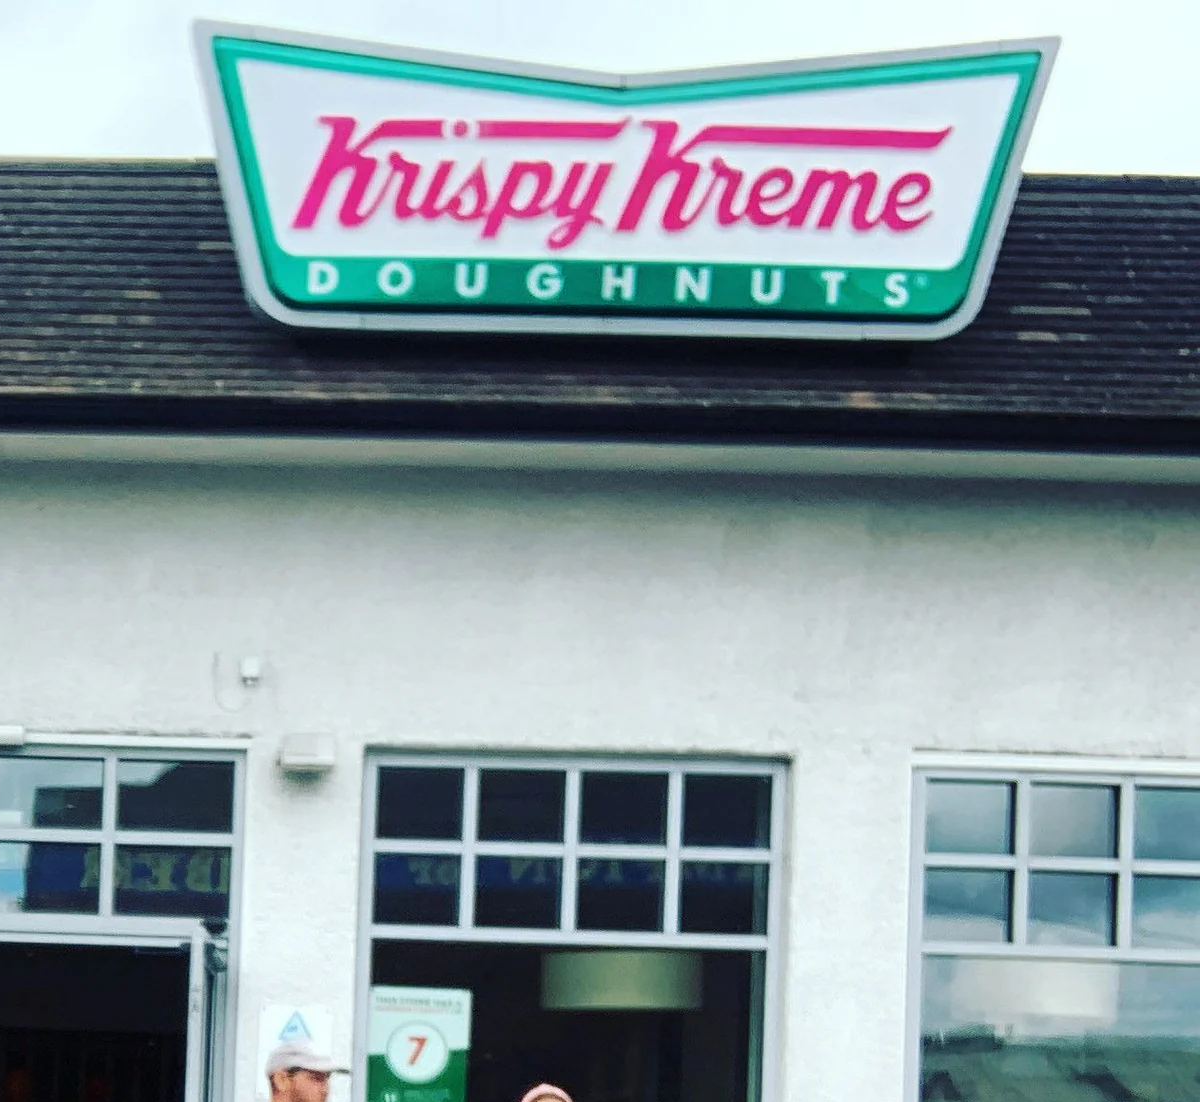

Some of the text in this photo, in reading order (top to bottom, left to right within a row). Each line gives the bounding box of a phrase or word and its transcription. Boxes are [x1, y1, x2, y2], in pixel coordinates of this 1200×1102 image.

[290, 114, 954, 250] Krispy Kreme
[307, 259, 911, 307] DOUGHNUTS
[407, 1035, 429, 1067] 7
